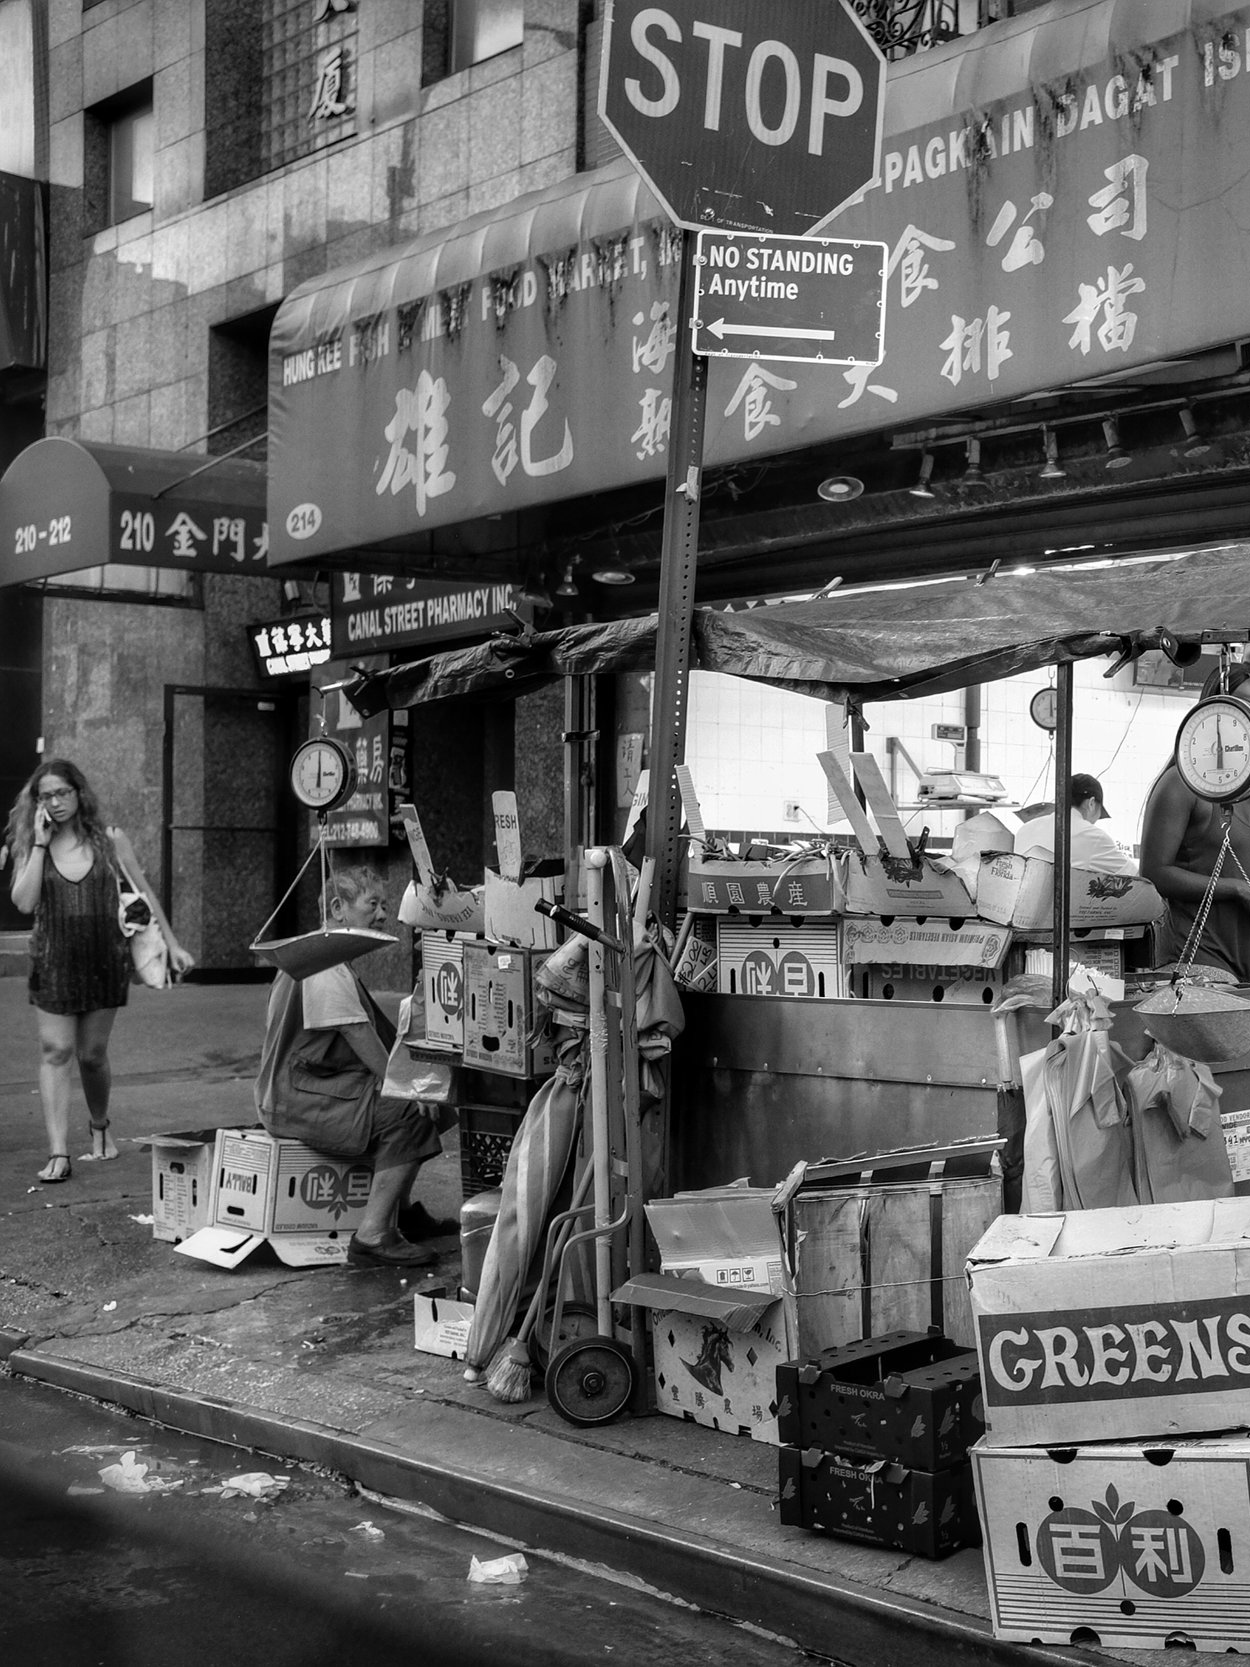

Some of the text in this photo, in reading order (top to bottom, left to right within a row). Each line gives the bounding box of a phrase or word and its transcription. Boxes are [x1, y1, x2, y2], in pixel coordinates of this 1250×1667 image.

[624, 8, 864, 156] STOP
[1056, 54, 1180, 138] DAGAT
[709, 245, 854, 276] NO STANDING
[708, 273, 799, 301] Anytime
[283, 350, 315, 387] HUNG
[317, 341, 342, 375] KEE
[119, 510, 155, 552] 210
[290, 510, 317, 532] 214
[347, 583, 518, 642] CANAL STREET PHARMACY INC.
[908, 931, 941, 943] VEGETABLES
[940, 932, 959, 944] ASIAN
[830, 1383, 886, 1401] FRESH OKRA
[829, 1466, 858, 1480] FRESH
[1049, 1523, 1189, 1582] 百利
